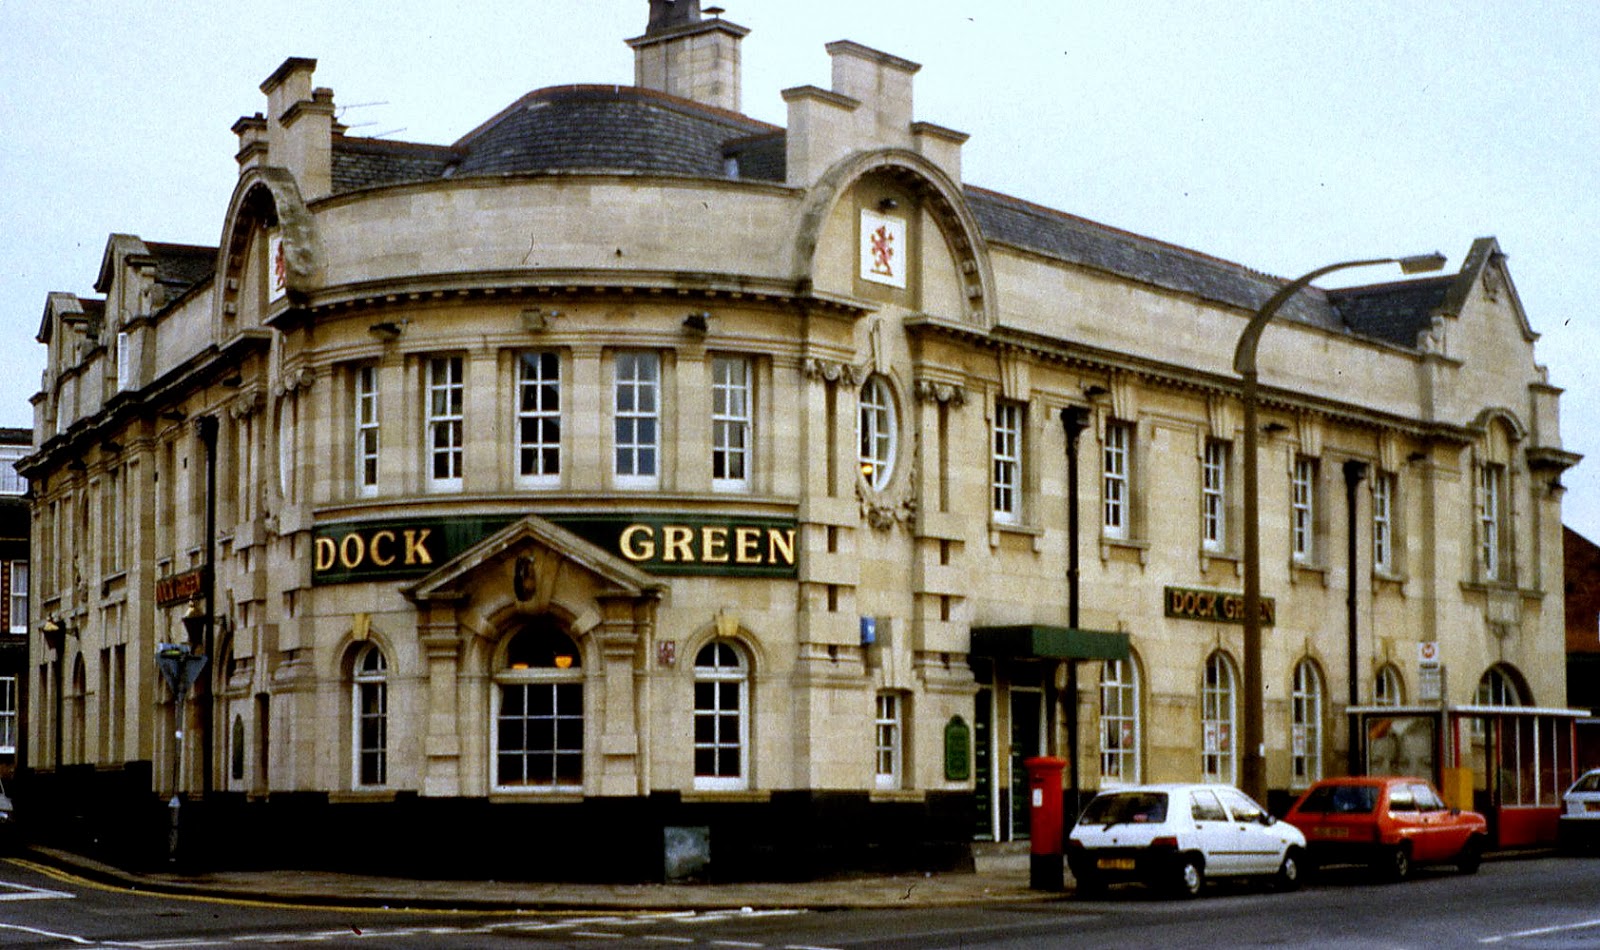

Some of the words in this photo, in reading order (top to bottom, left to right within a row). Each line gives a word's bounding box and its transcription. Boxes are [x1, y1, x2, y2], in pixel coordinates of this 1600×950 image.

[314, 528, 434, 571] DOCK
[619, 523, 797, 565] GREEN
[1172, 591, 1216, 616] DOCK
